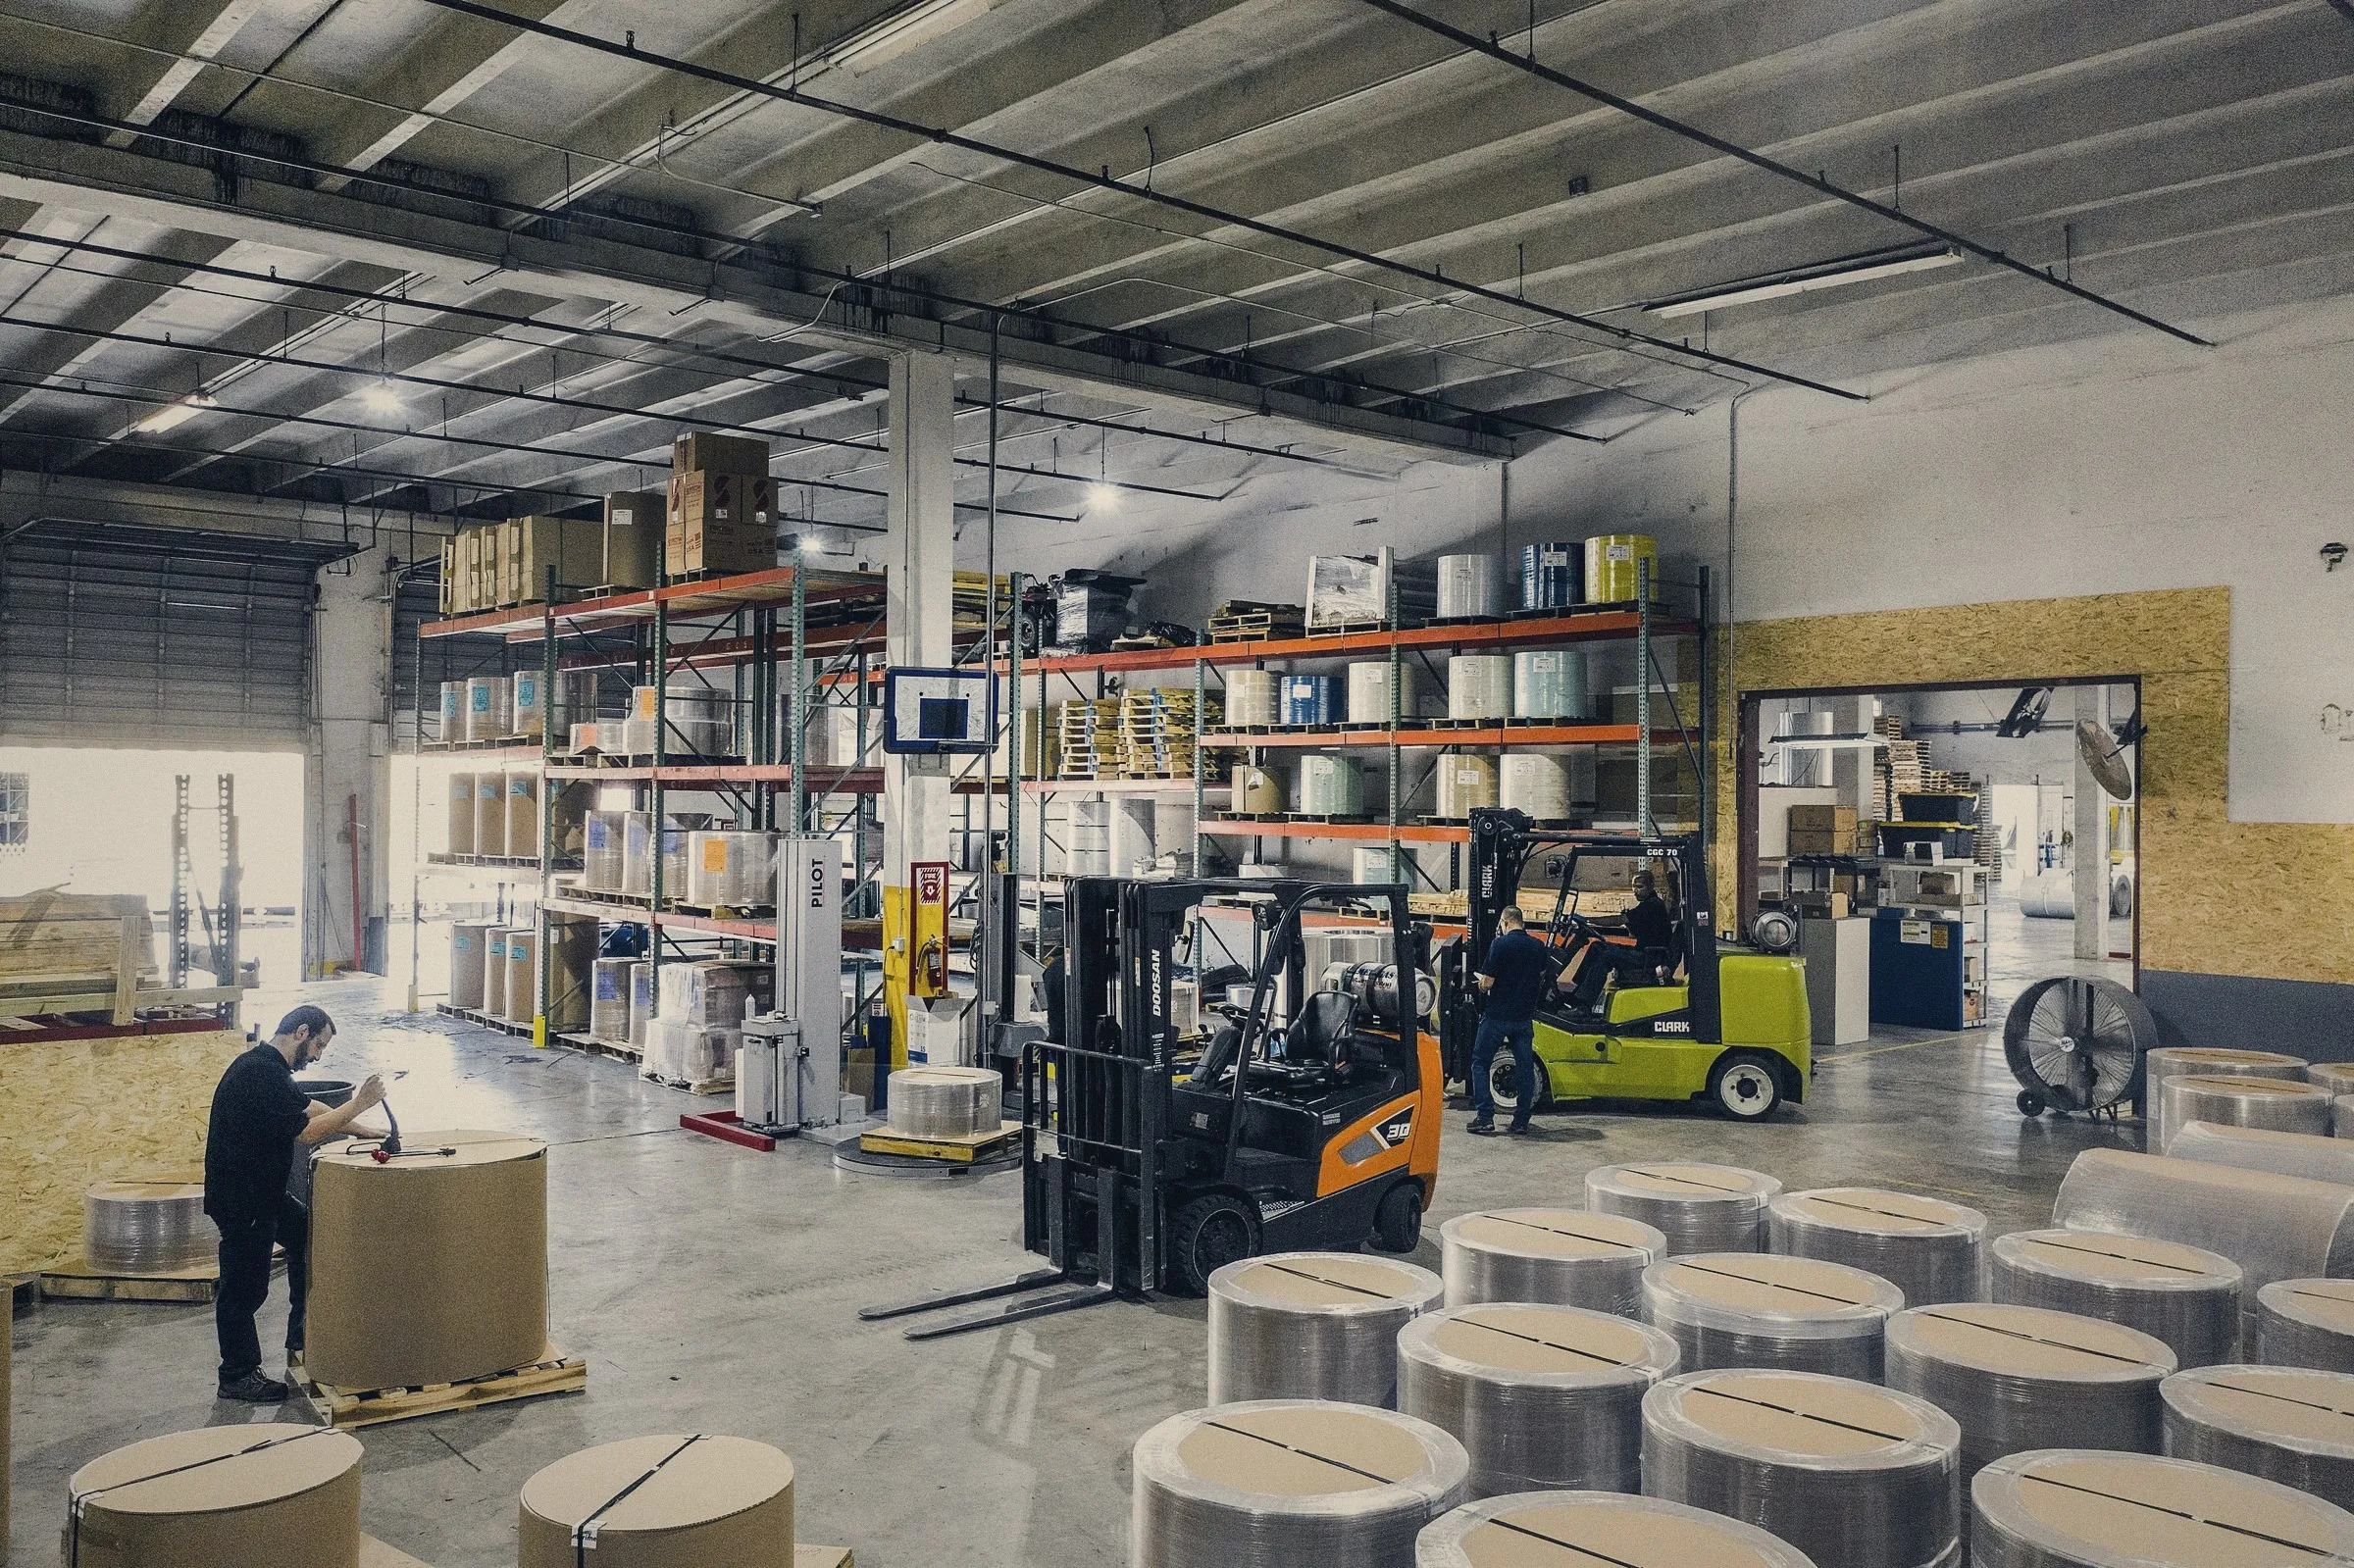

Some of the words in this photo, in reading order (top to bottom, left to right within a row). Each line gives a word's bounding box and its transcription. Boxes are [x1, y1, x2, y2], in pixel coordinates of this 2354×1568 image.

[811, 858, 823, 908] PILOT
[1482, 865, 1493, 898] CLARK
[1151, 948, 1161, 1017] DOOSAN
[1654, 1021, 1690, 1033] CLARK
[1387, 1123, 1411, 1140] 30
